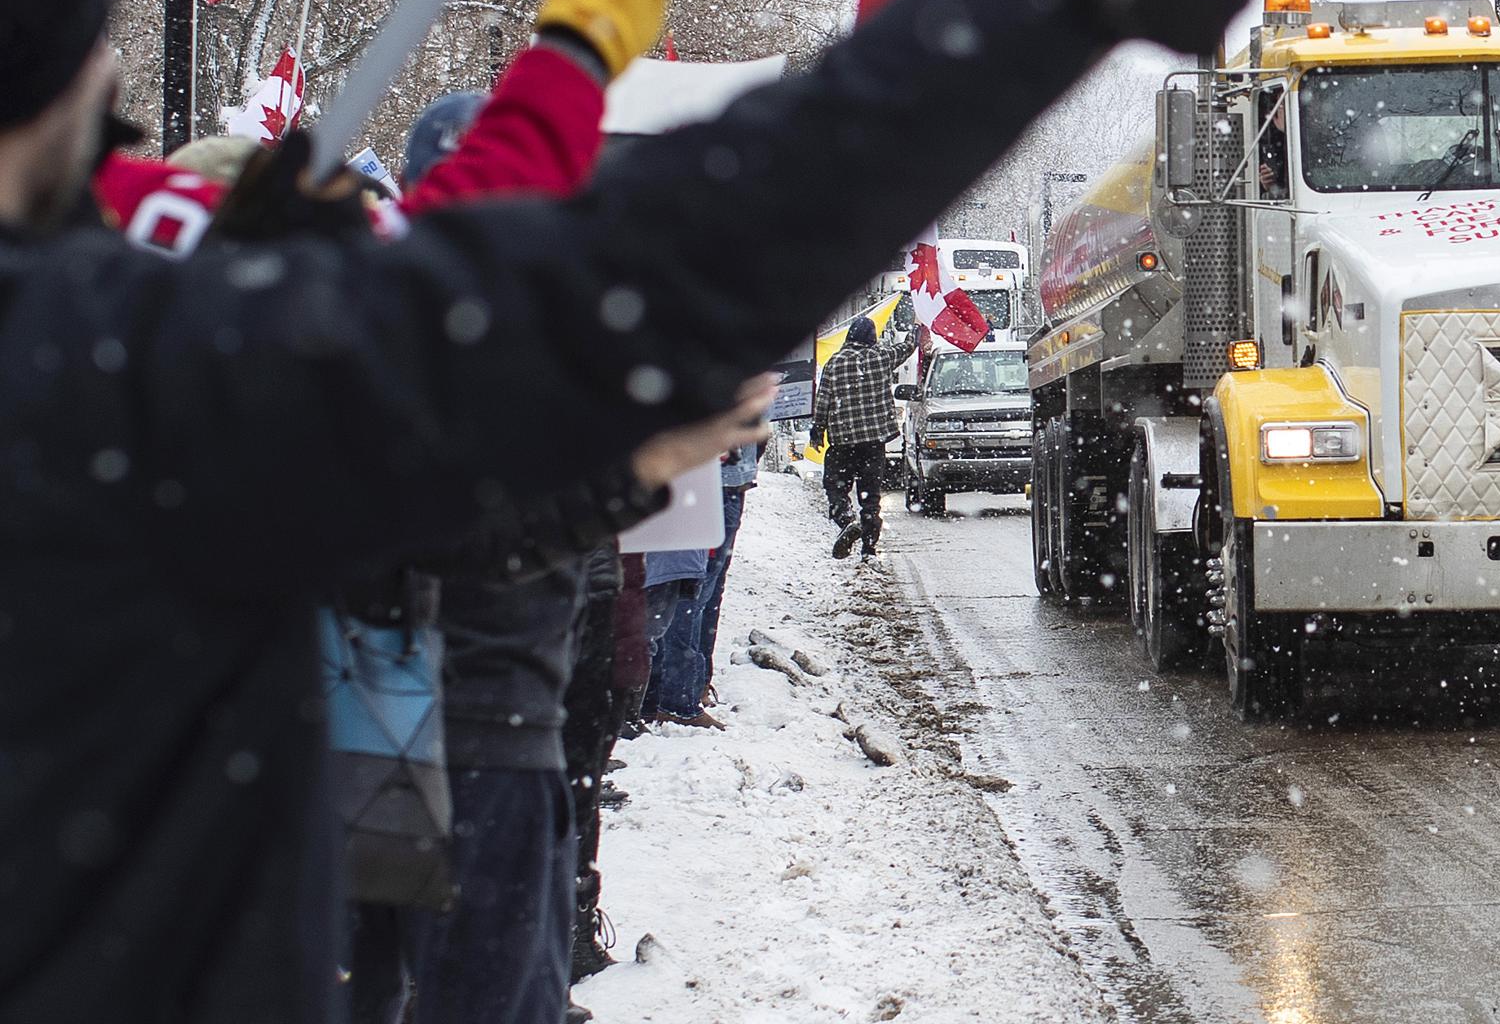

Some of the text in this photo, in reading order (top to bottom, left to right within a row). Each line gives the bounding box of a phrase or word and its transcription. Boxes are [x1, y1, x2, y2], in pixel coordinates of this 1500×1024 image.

[1369, 199, 1500, 220] THANK
[1379, 228, 1402, 236] &
[1414, 214, 1491, 228] THE
